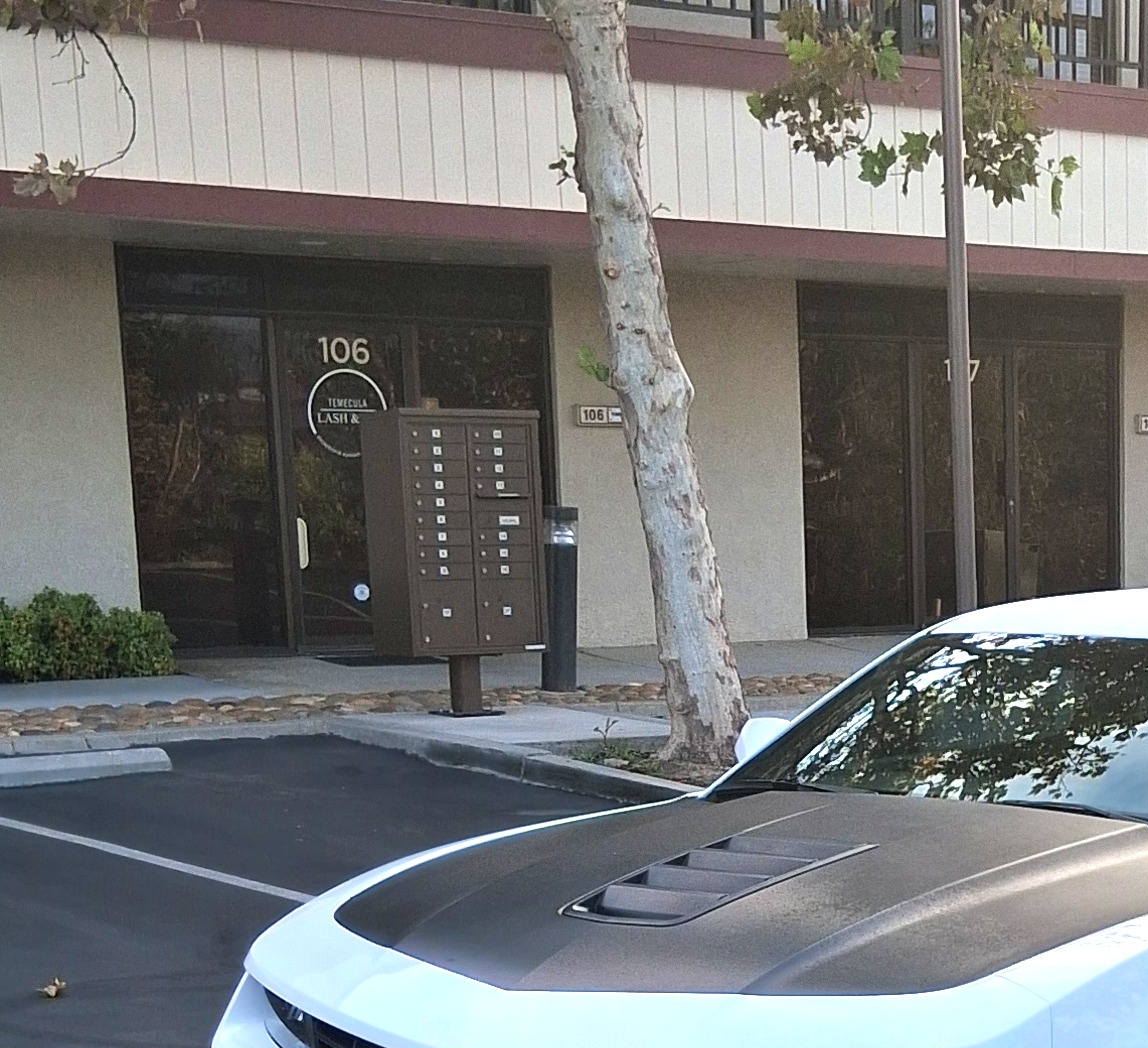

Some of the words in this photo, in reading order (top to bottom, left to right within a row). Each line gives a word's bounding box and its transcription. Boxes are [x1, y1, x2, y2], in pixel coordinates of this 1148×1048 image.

[318, 336, 370, 364] 106
[943, 359, 981, 382] 17
[328, 398, 368, 408] TEMECULA
[317, 412, 349, 424] LASH
[583, 409, 604, 421] 106
